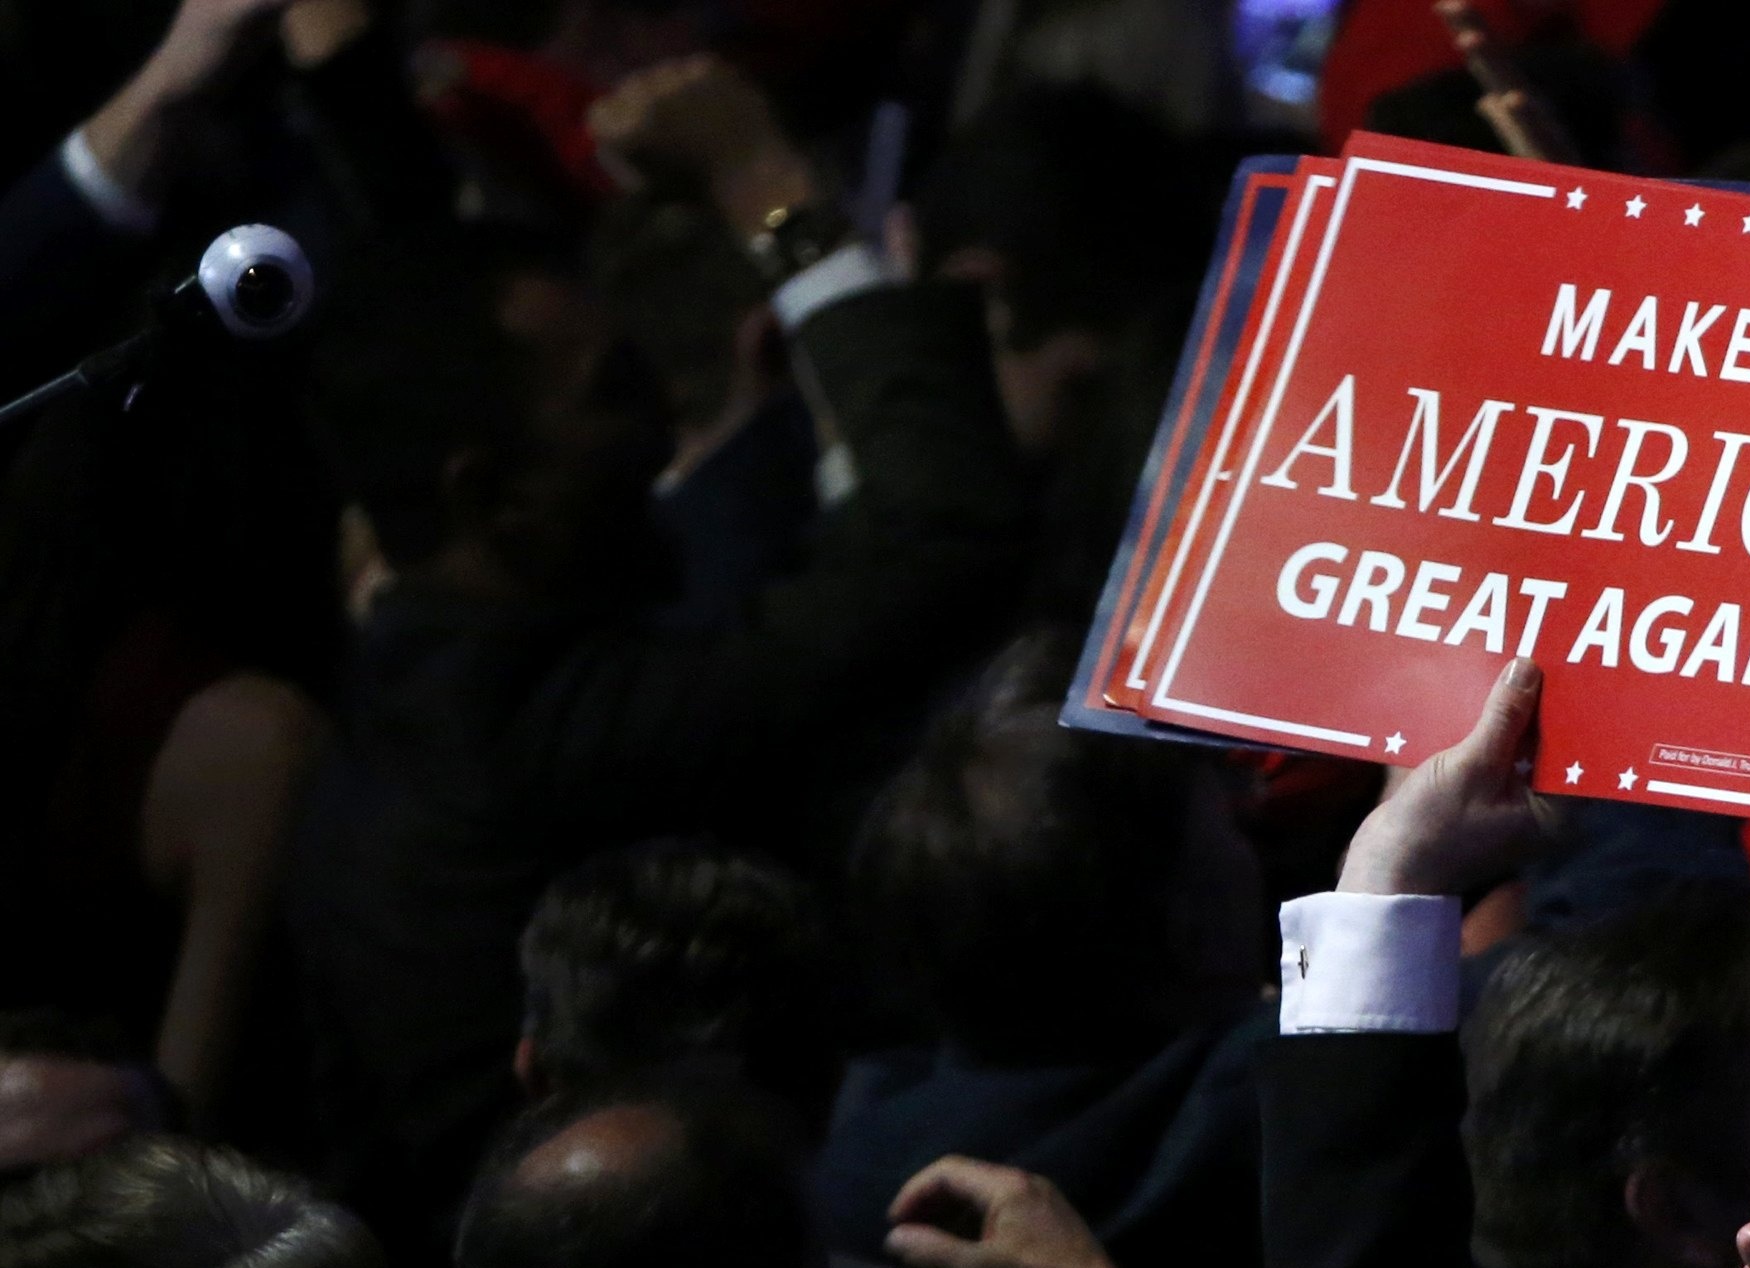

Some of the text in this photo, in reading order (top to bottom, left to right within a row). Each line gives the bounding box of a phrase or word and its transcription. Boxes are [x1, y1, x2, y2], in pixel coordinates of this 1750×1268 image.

[1276, 541, 1568, 660] GREAT
[1658, 748, 1677, 761] Paid
[1678, 751, 1690, 762] for
[1690, 752, 1701, 766] by
[1701, 754, 1732, 769] Donald
